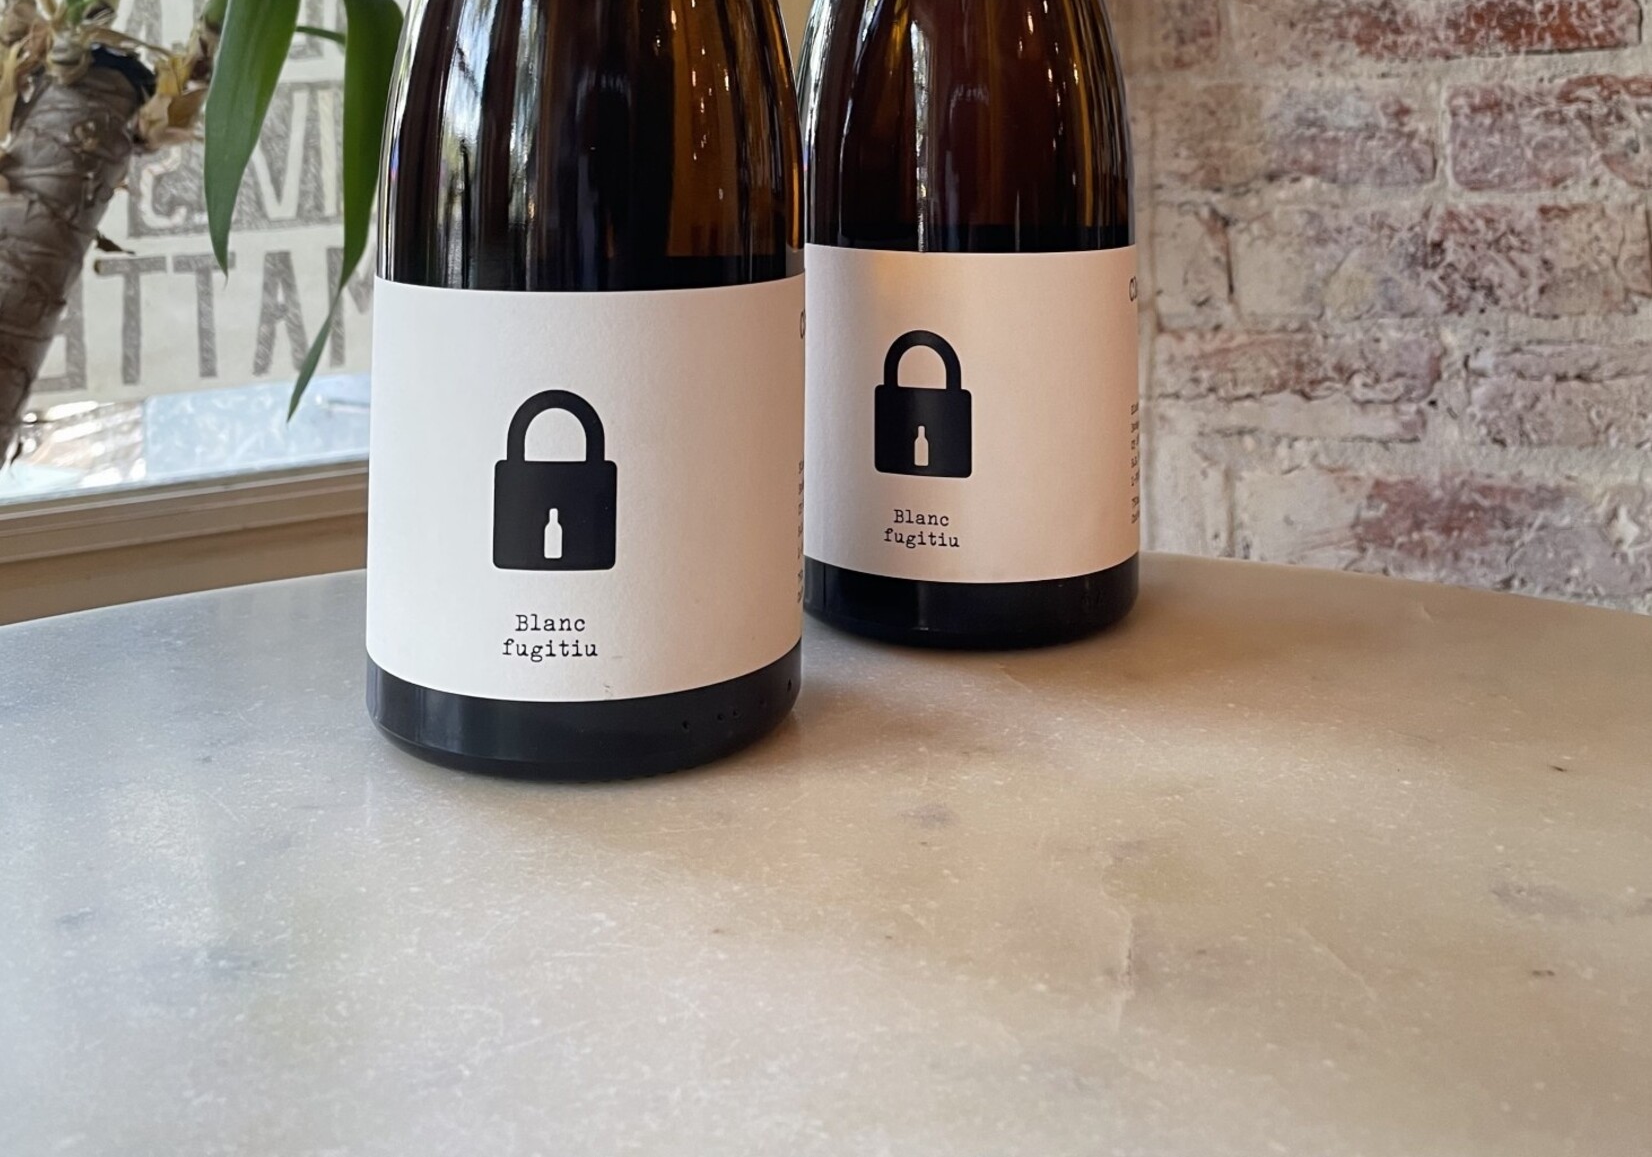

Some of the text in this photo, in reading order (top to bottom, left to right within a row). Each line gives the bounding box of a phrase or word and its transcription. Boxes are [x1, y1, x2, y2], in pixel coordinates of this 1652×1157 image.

[893, 508, 950, 527] Blanc
[884, 527, 960, 549] fugitiu
[515, 613, 586, 632] Blanc
[502, 638, 598, 663] fugitiu
